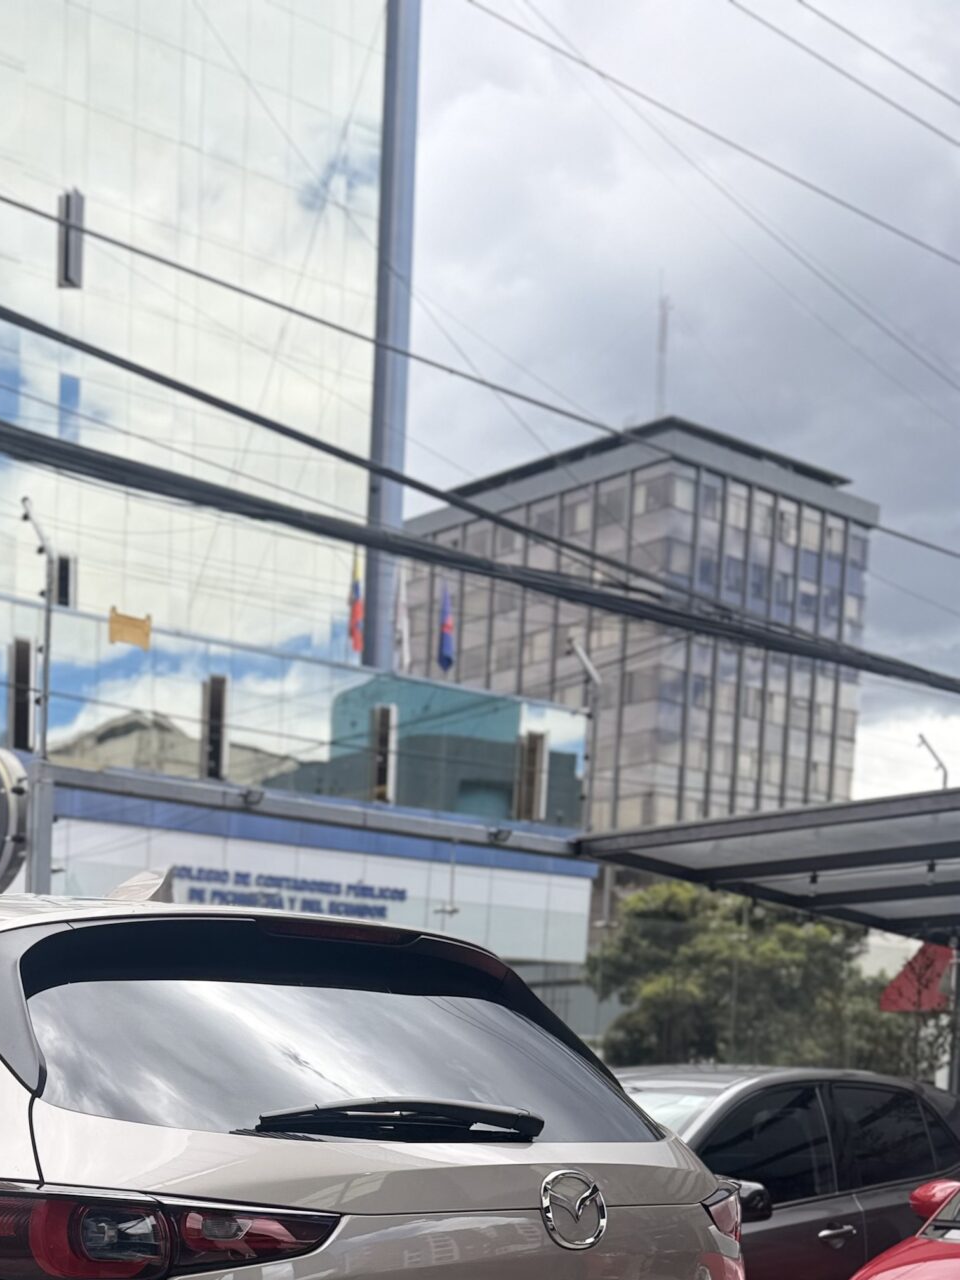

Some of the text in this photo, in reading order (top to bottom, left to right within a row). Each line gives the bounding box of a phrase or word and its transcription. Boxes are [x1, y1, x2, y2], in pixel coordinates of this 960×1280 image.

[234, 870, 250, 887] DE
[256, 873, 341, 896] CONTADORES
[188, 886, 205, 904] DE
[301, 898, 324, 913] DEL
[328, 900, 387, 920] ECUADOR
